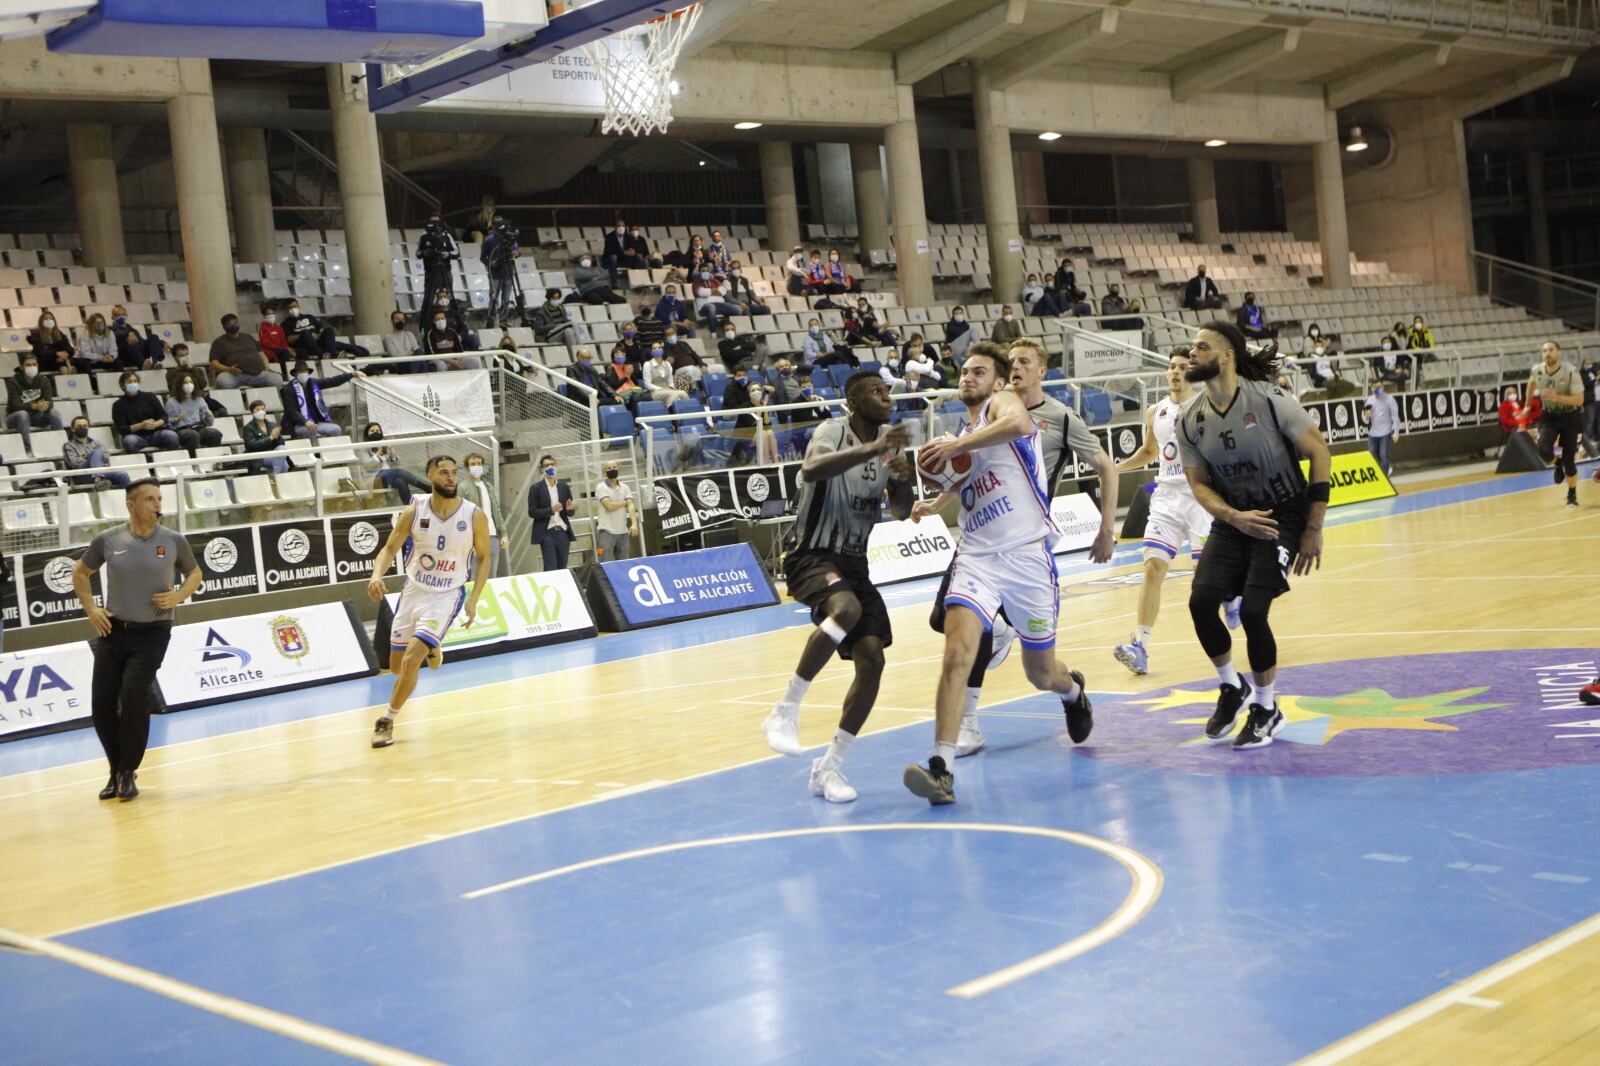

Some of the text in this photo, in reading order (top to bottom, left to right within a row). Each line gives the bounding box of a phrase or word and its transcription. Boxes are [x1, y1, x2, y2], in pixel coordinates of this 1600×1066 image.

[559, 56, 571, 65] DE
[552, 69, 600, 81] ESPORTIV
[1219, 430, 1237, 451] 16
[862, 462, 876, 481] 35
[964, 495, 1014, 533] ALICANTE
[437, 535, 446, 550] 8
[295, 565, 328, 579] ALICANTE
[673, 568, 748, 589] DIPUTACIÓN
[223, 574, 257, 589] ALICANTE
[679, 582, 755, 602] DE ALICANTE
[526, 622, 562, 634] 1919-2019
[200, 669, 264, 689] Alicante
